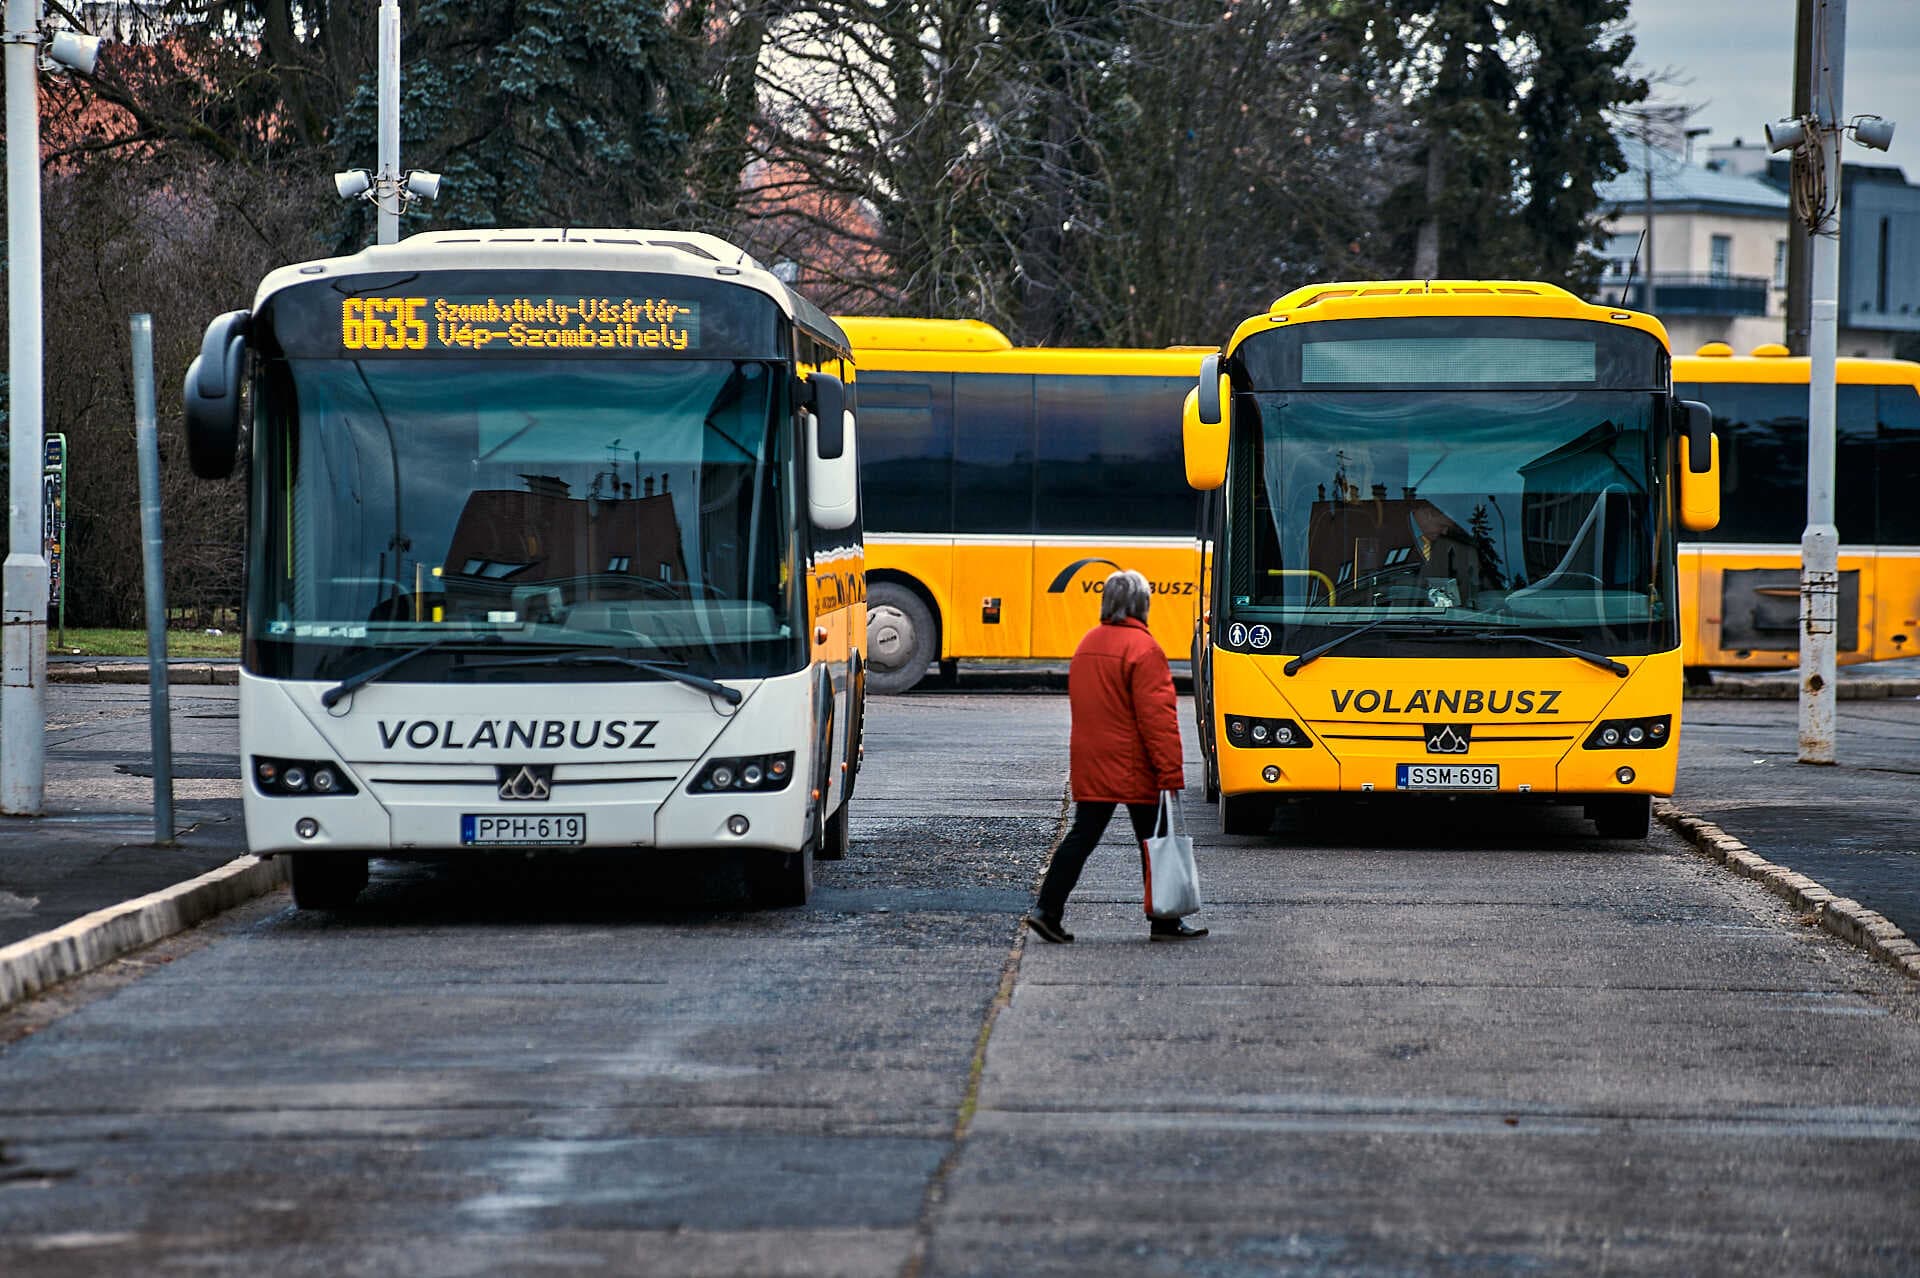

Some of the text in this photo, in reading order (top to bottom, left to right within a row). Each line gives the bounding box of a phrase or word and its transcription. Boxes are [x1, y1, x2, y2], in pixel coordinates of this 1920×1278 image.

[342, 298, 428, 349] 6635
[437, 322, 689, 350] Vép-Szombathely
[1081, 580, 1194, 595] VOBUSZ
[1331, 689, 1562, 714] VOLÁNBUSZ
[377, 720, 660, 750] VOLÁNBUSZ
[1412, 768, 1493, 784] SSM-696
[480, 818, 578, 837] PPH-619
